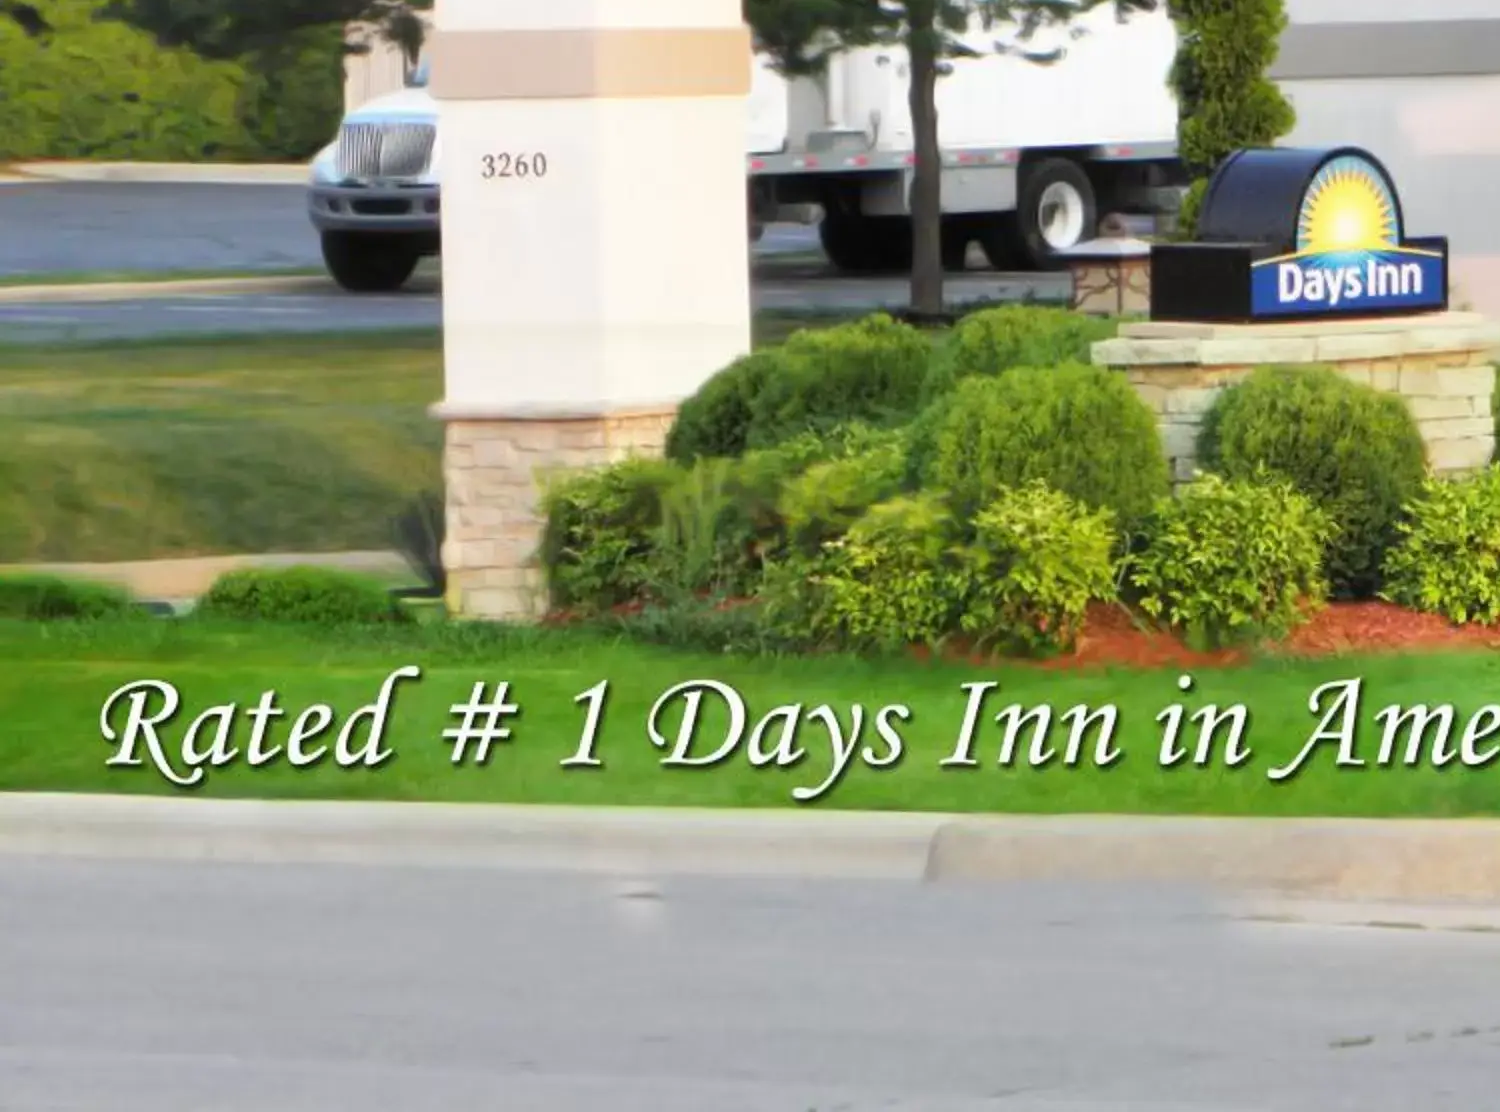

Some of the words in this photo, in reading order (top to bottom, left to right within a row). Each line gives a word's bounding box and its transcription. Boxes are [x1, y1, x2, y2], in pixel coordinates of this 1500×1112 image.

[481, 152, 548, 179] 3260
[1278, 262, 1363, 306] Days
[1366, 259, 1423, 297] Inn
